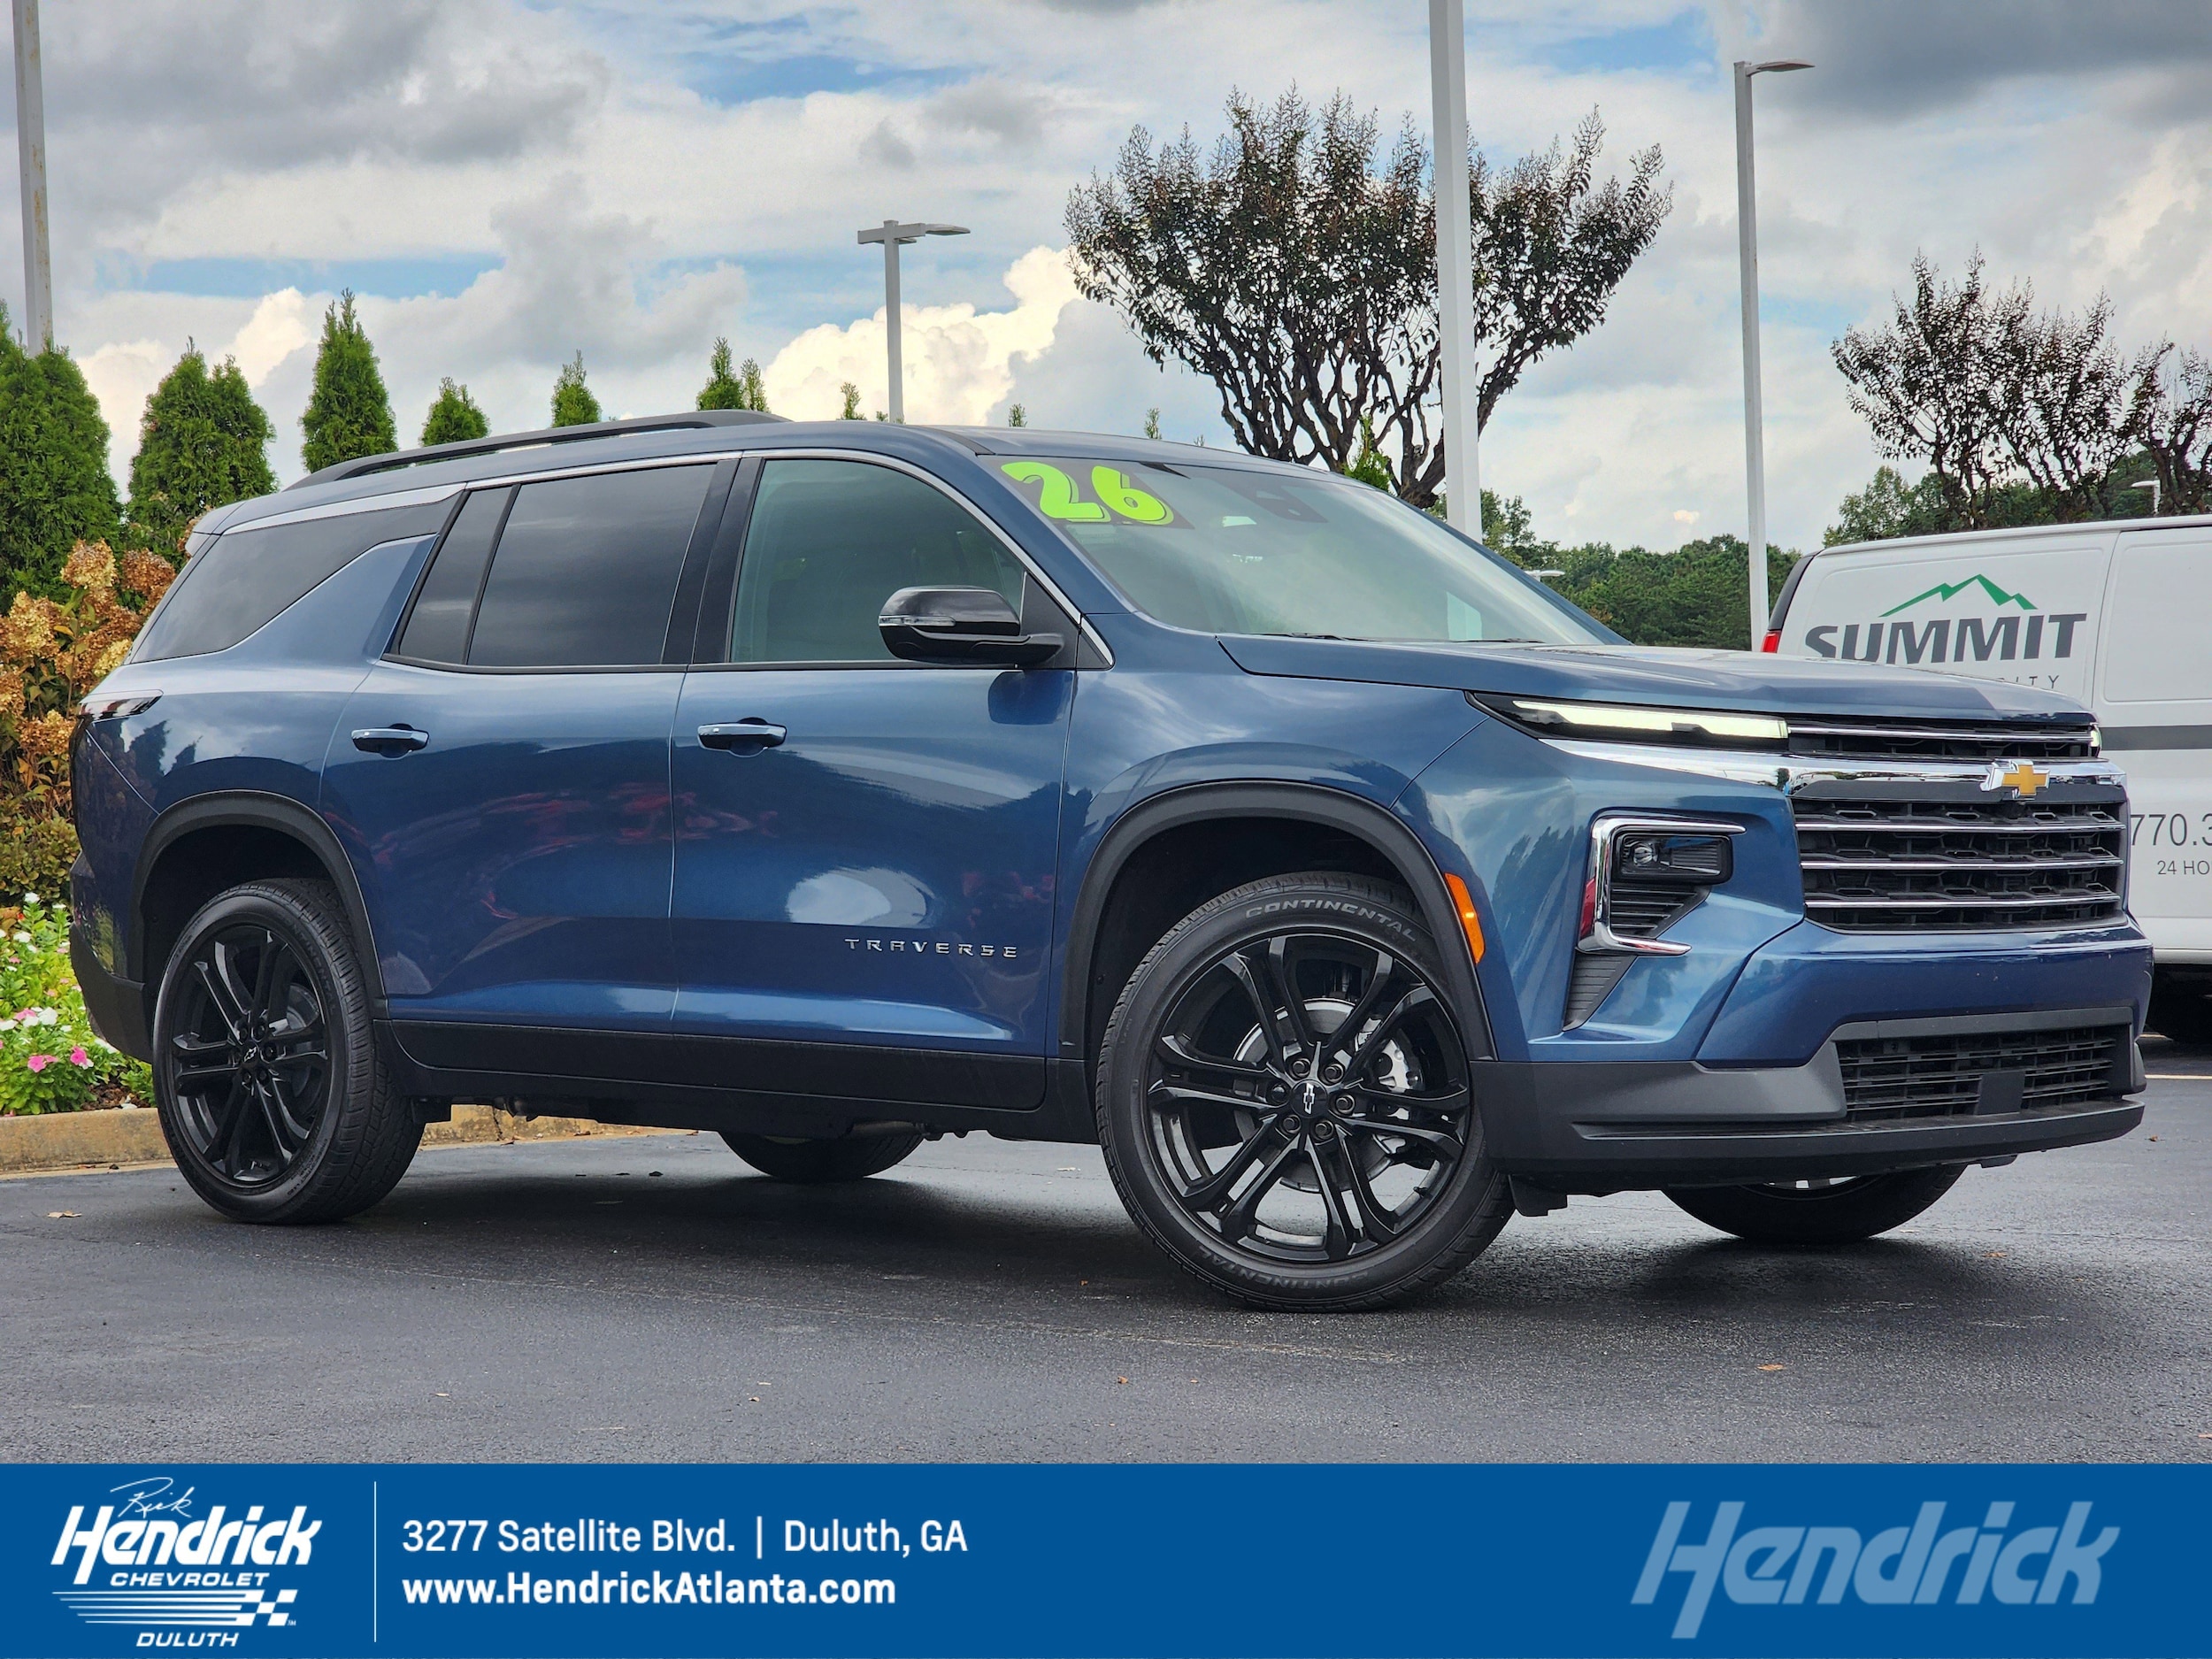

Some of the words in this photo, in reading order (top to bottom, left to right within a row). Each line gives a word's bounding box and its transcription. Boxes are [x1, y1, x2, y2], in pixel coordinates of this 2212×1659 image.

[1001, 461, 1174, 526] 26
[1804, 612, 2088, 665] SUMMIT
[2157, 860, 2177, 875] 24
[2183, 860, 2212, 875] HO
[1246, 899, 1417, 941] CONTINENTAL
[844, 938, 1018, 958] TRAVERSE
